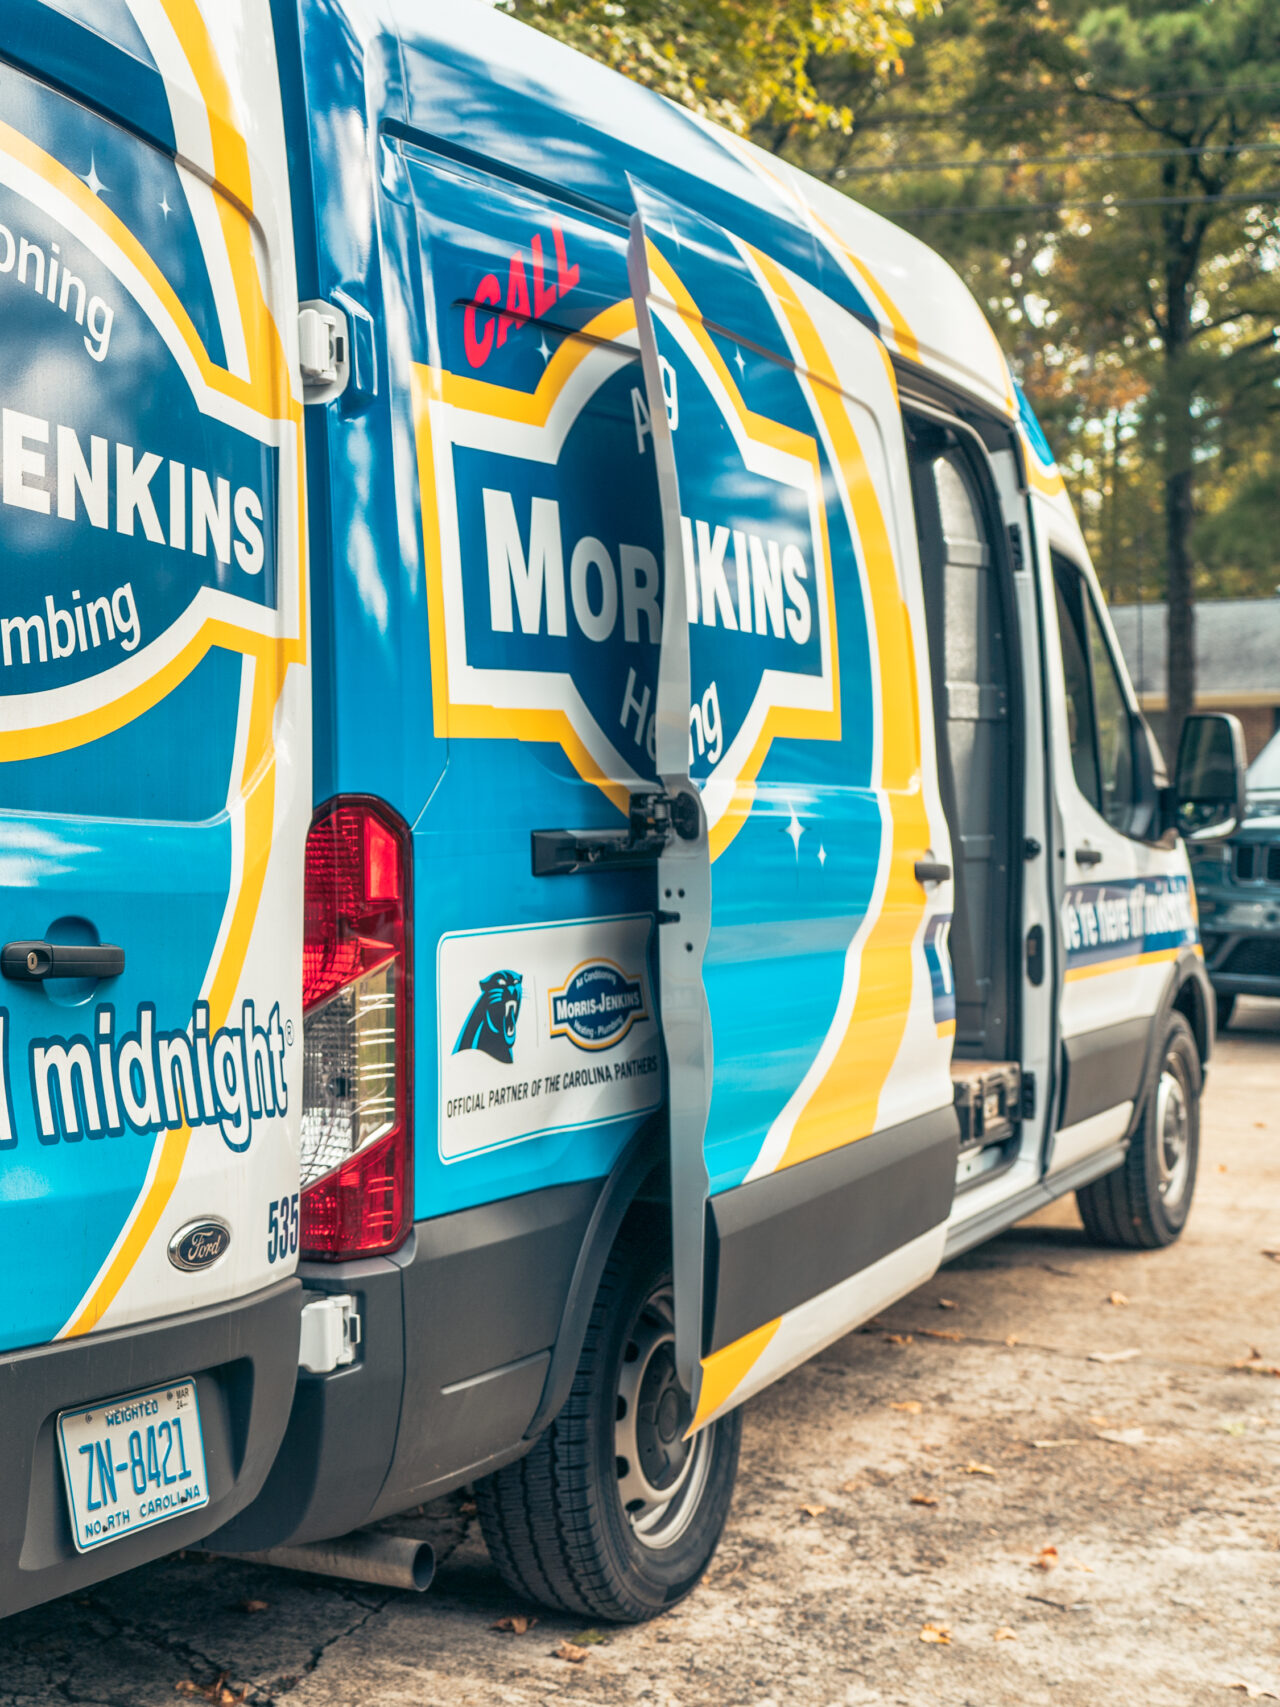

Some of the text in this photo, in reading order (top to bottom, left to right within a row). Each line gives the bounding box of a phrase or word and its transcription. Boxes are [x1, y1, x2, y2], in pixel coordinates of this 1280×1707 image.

[464, 220, 580, 369] CALL
[556, 991, 640, 1021] MORRIS-JENKINS
[447, 1055, 658, 1118] OFFICIAL PARTNER OF THE CAROLINA PANTHERS
[187, 1230, 222, 1261] Ford
[267, 1192, 299, 1264] 535
[104, 1399, 159, 1427] WEIGHTED
[175, 1387, 189, 1400] MAR
[78, 1417, 192, 1511] ZN-8421
[84, 1484, 201, 1539] NORTH CAROLINA
